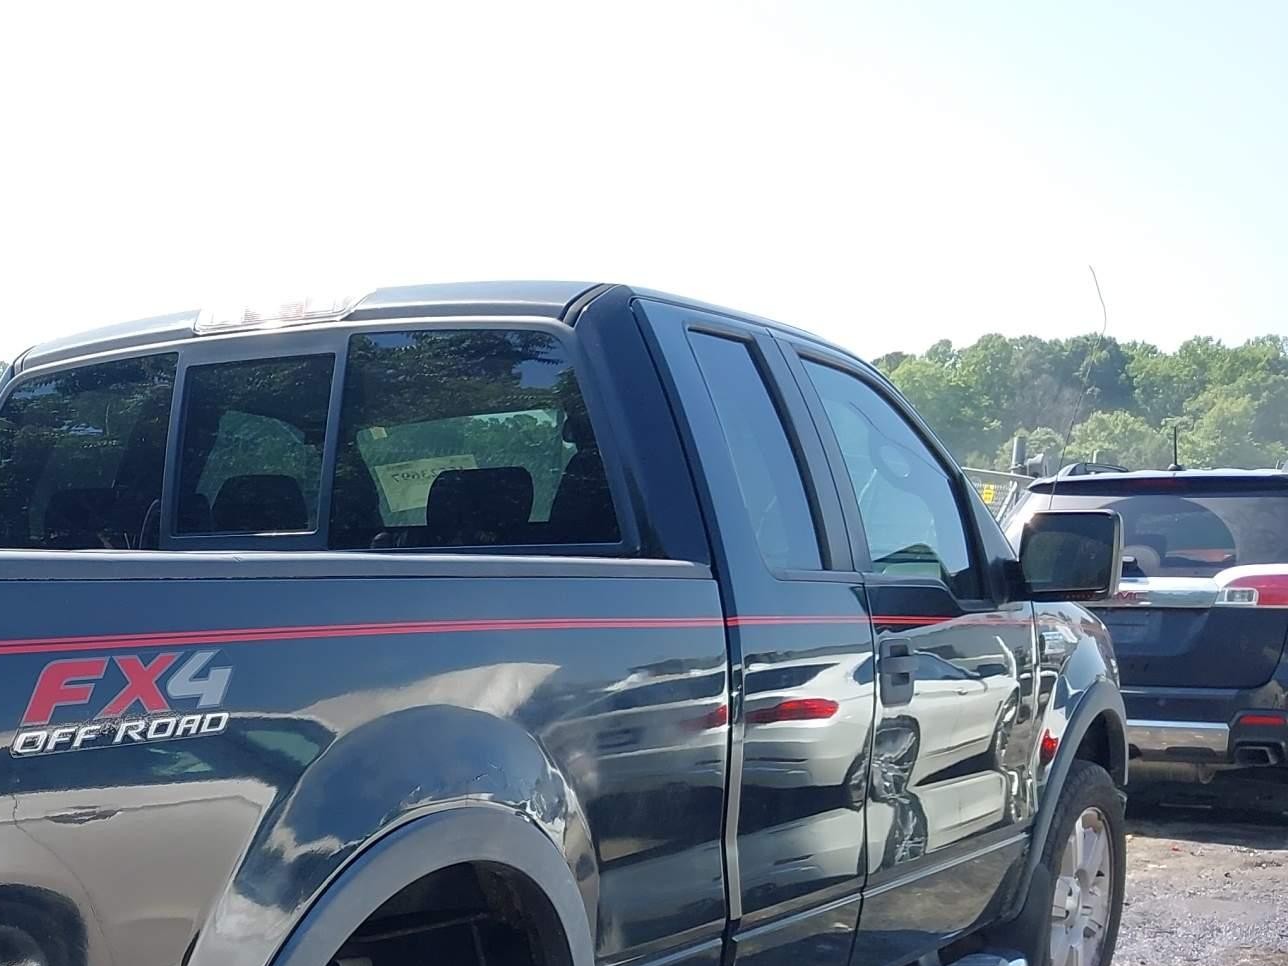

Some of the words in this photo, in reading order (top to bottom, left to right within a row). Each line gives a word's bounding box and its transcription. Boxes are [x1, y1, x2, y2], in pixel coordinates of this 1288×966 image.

[19, 650, 233, 727] FX4
[11, 725, 102, 757] OFF
[111, 712, 230, 746] ROAD
